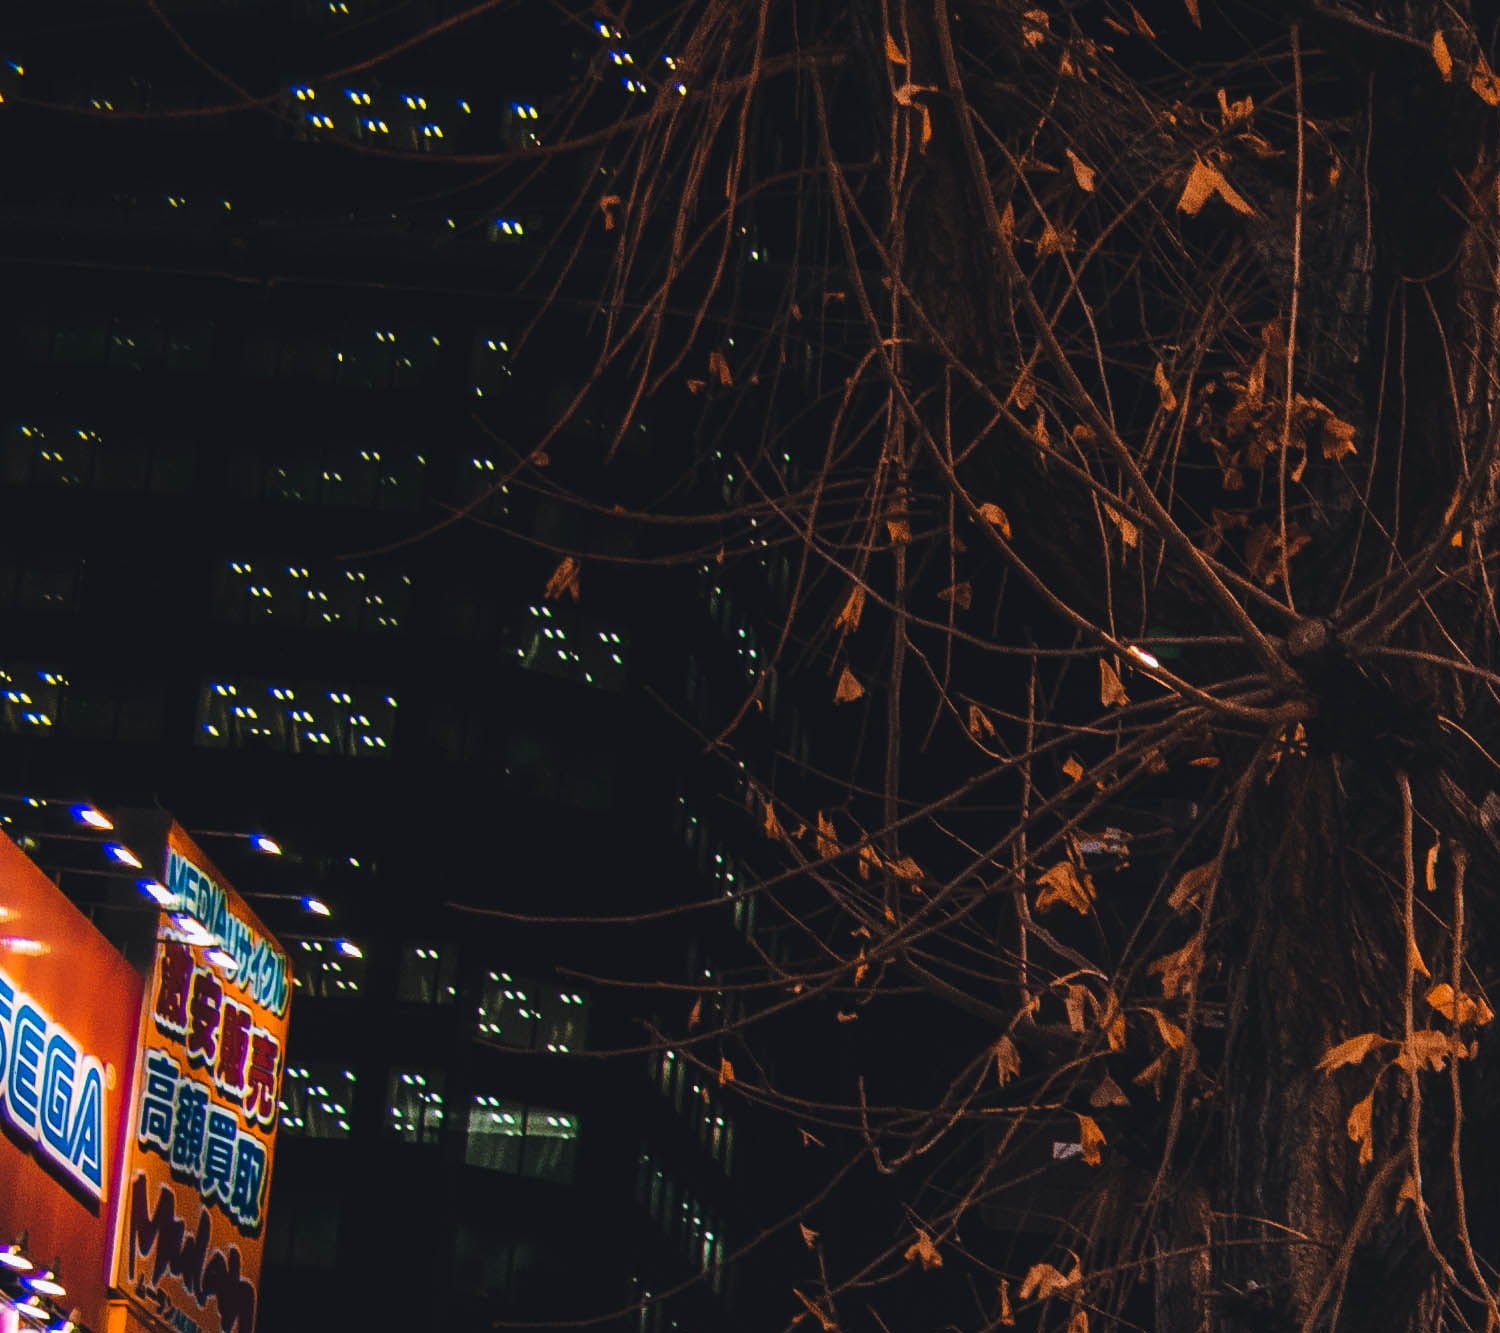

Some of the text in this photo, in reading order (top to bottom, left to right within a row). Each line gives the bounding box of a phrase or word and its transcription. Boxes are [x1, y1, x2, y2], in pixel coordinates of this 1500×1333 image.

[0, 978, 102, 1194] EGA
[138, 1048, 268, 1228] 高額買取
